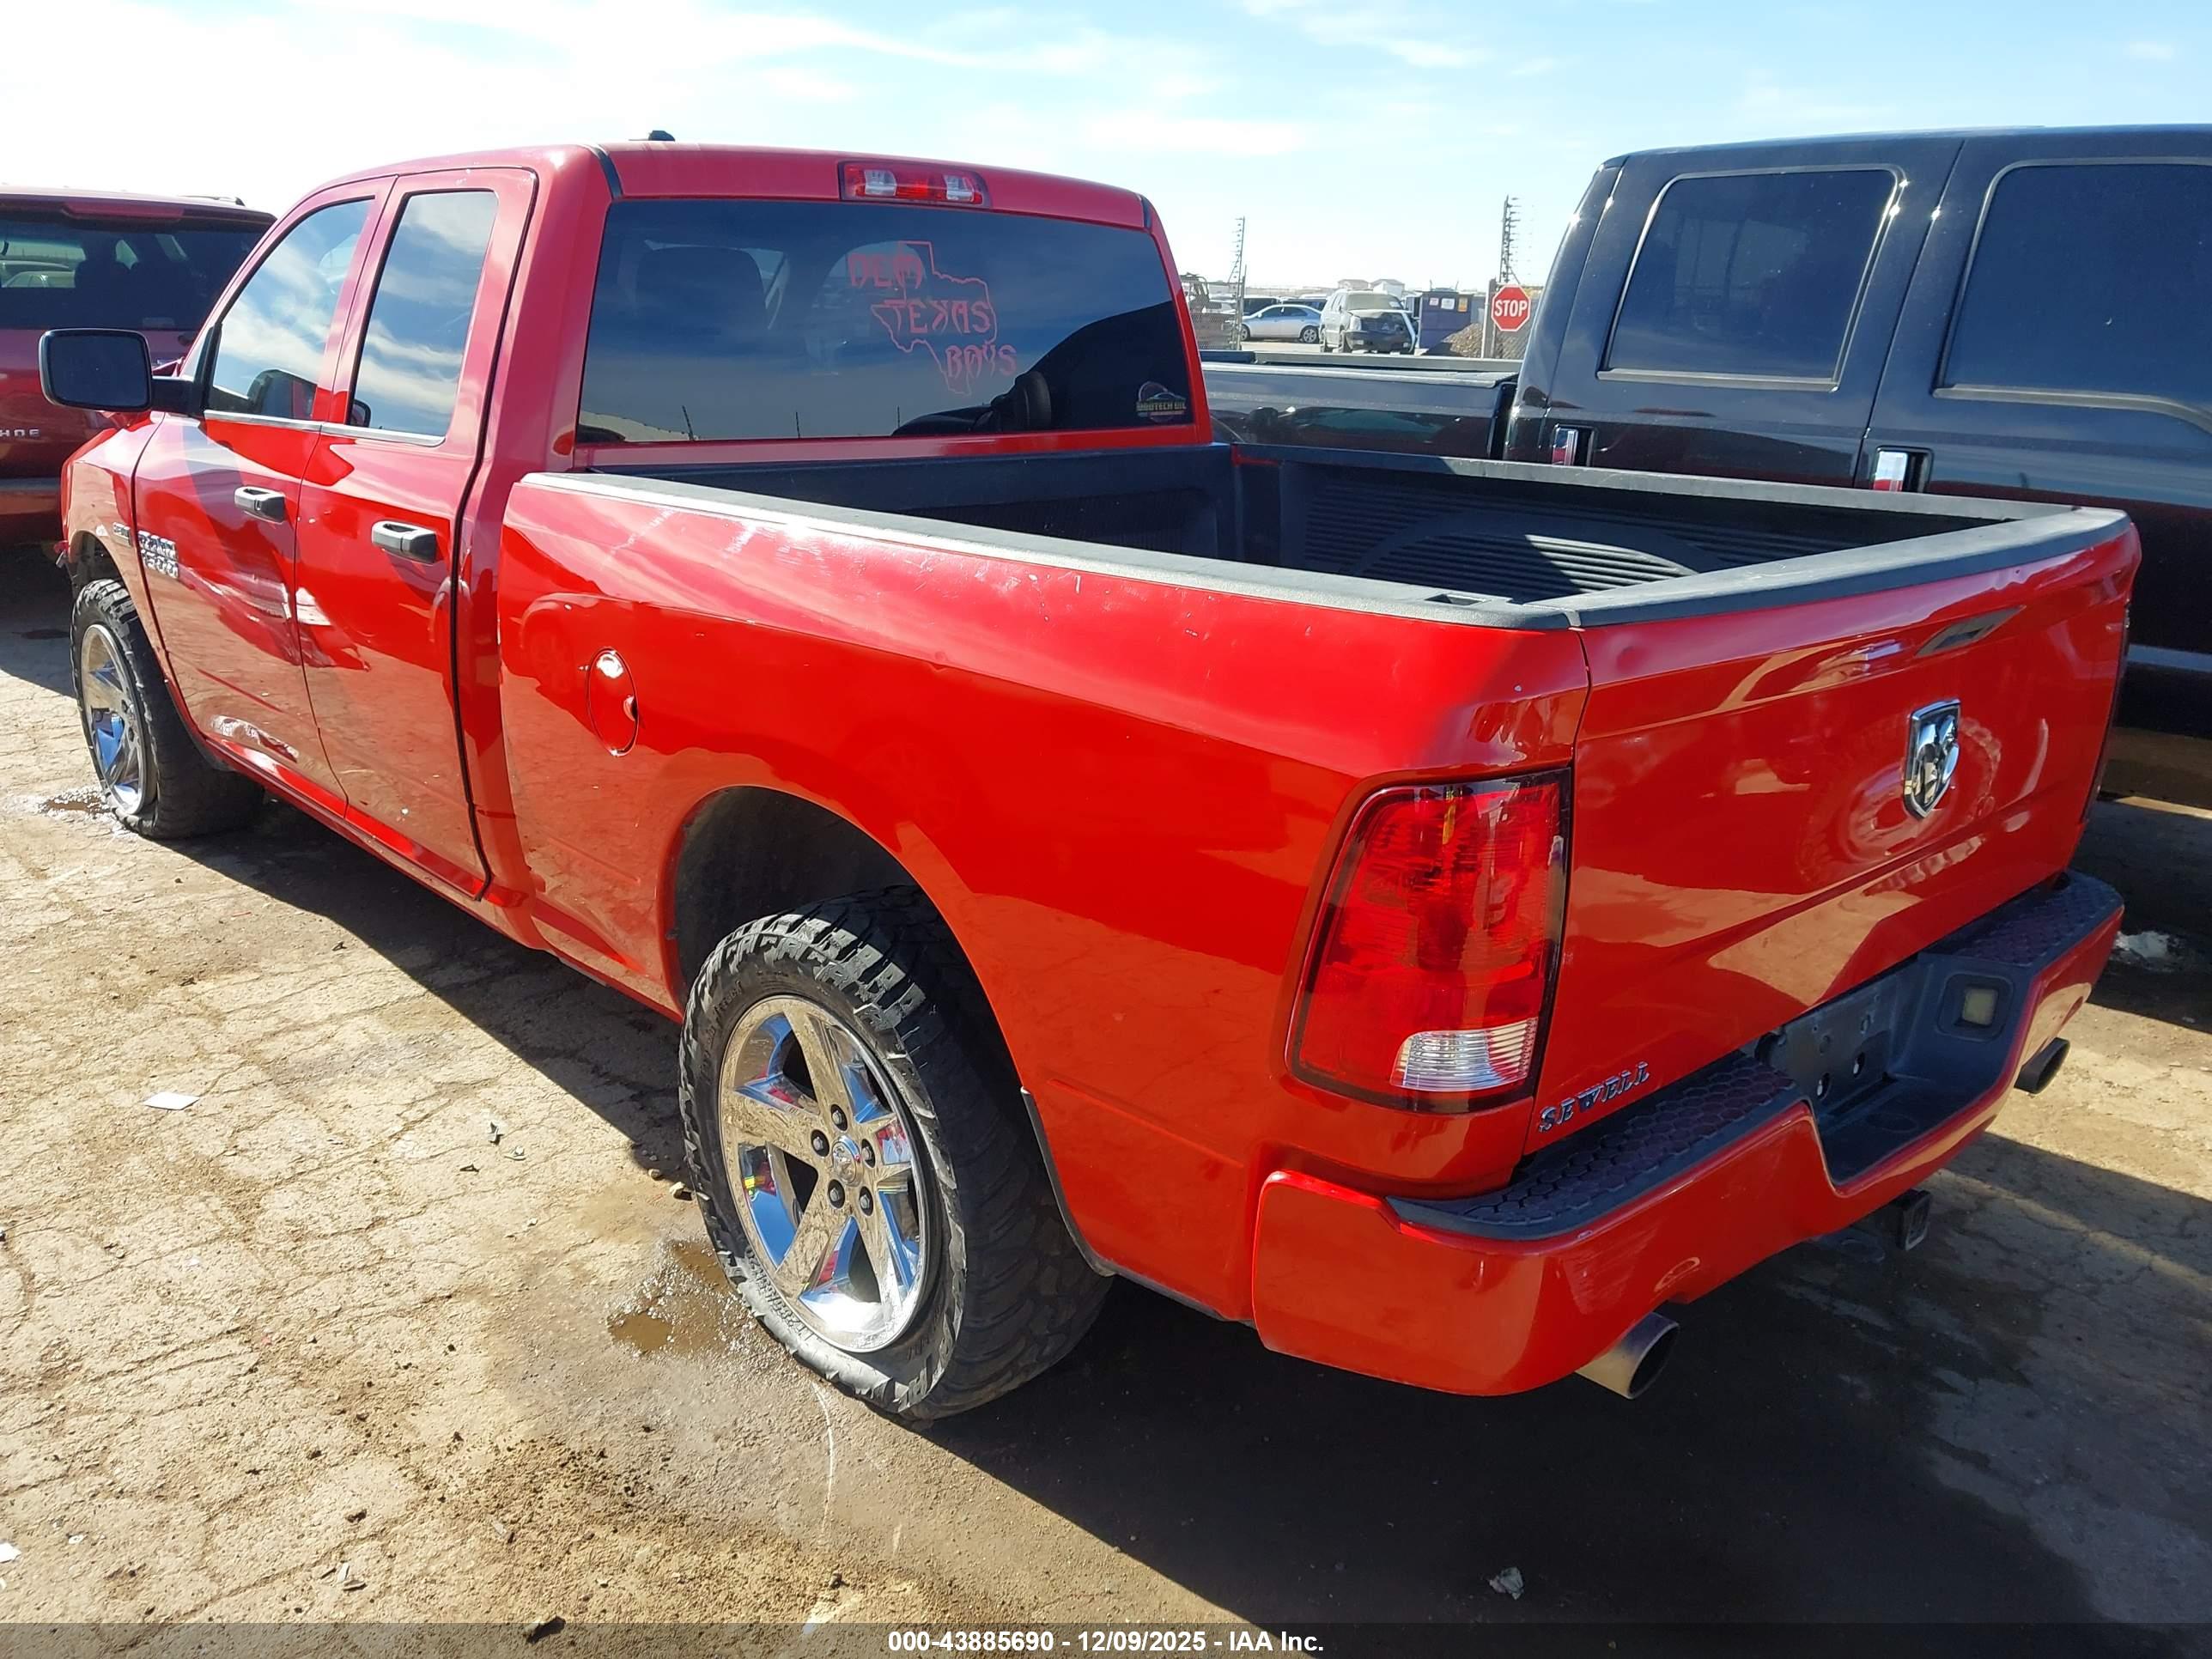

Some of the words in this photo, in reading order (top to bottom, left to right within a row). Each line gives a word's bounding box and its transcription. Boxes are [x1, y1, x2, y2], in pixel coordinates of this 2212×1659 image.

[884, 298, 991, 334] TEXAS
[1494, 300, 1528, 317] STOP
[1539, 1061, 1650, 1133] SEWELL
